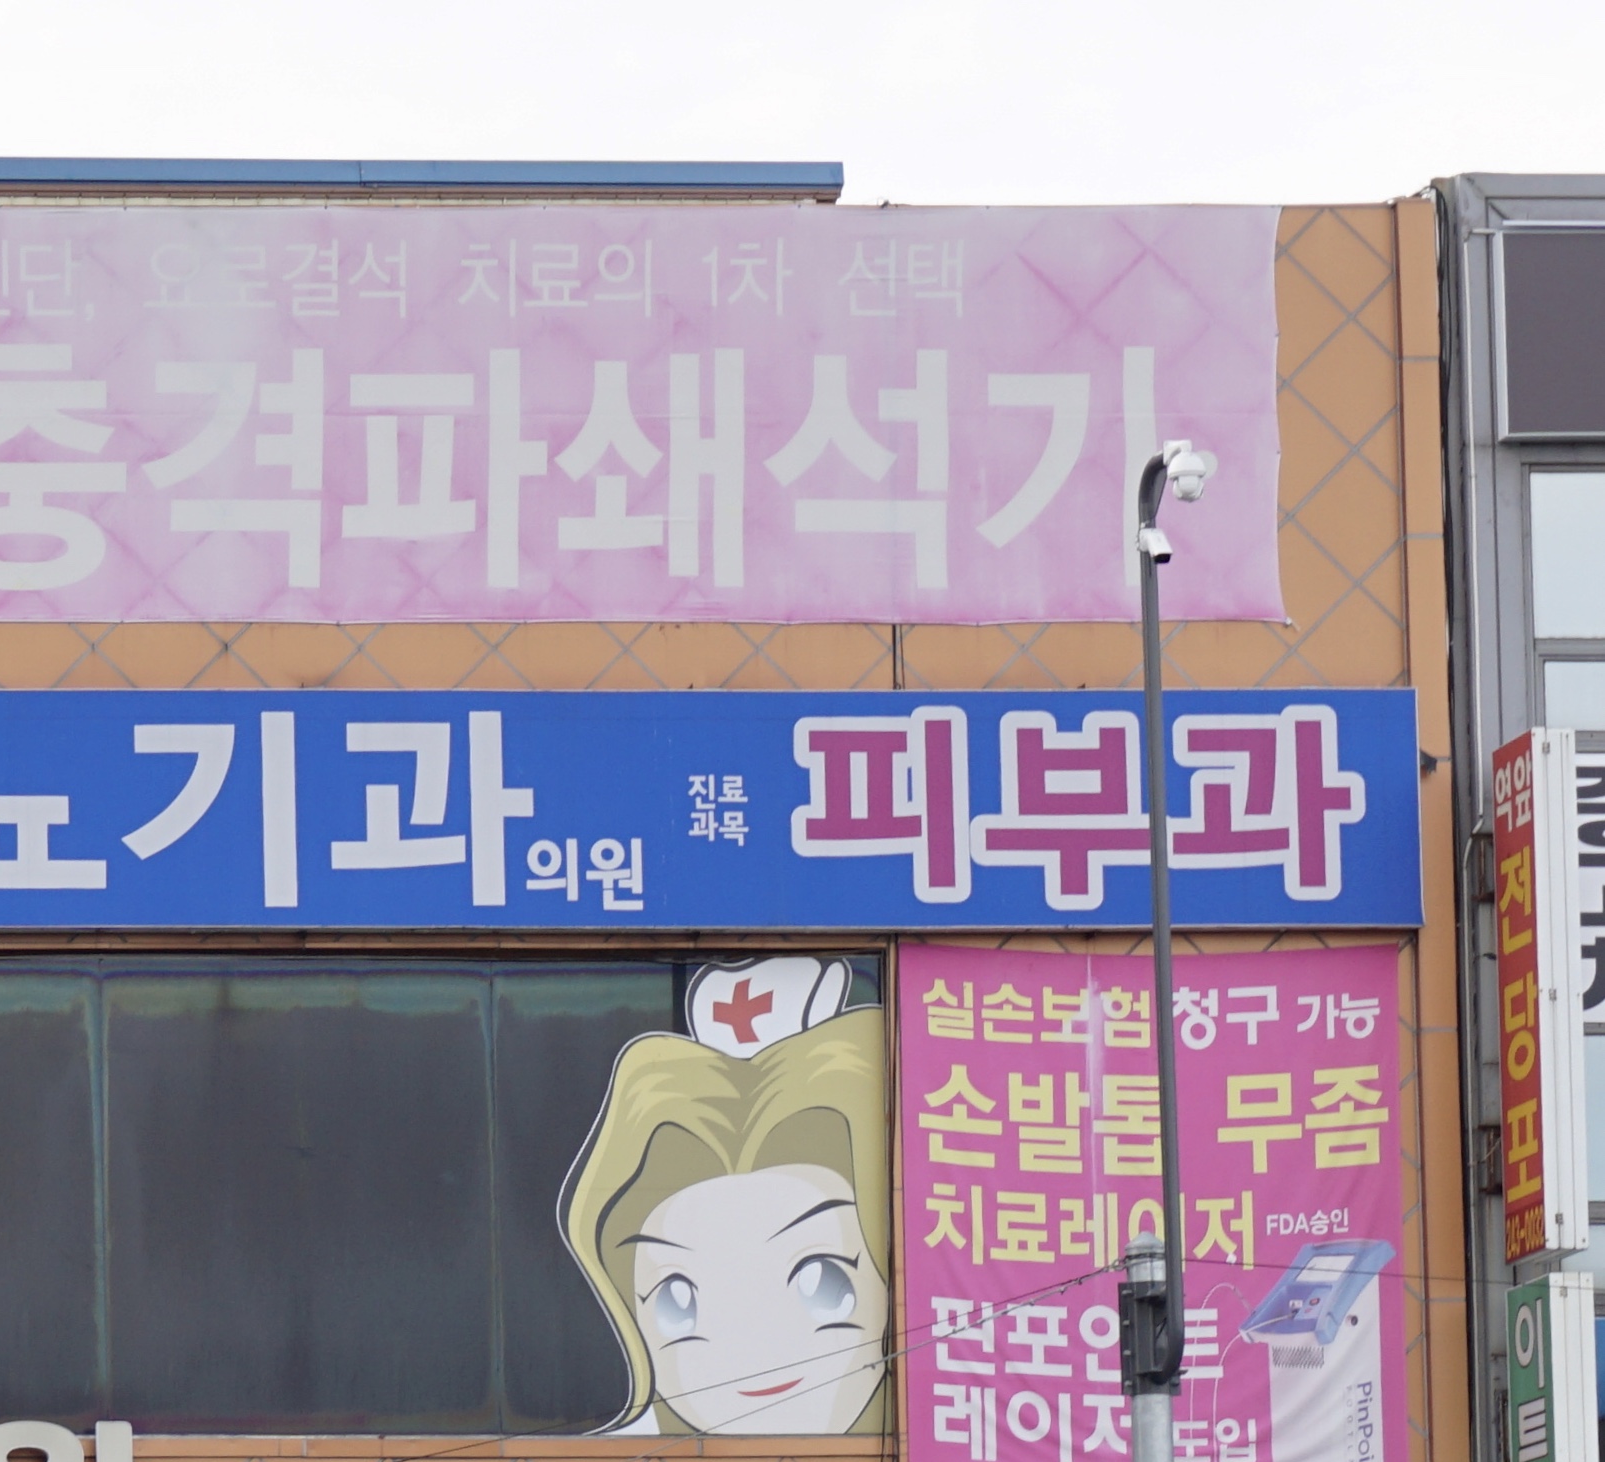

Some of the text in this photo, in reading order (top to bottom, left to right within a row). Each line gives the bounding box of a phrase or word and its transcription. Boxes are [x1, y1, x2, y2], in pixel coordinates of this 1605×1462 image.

[141, 238, 408, 318] 요로결석
[456, 237, 655, 318] 치료의
[701, 237, 793, 317] 1차
[837, 238, 965, 318] 선택
[688, 773, 750, 809] 진료
[791, 704, 1366, 911] 피부과
[688, 811, 751, 847] 과목
[525, 835, 645, 911] 의원
[1297, 991, 1381, 1041] 가능
[918, 1063, 1389, 1177] 손발톱 무좀
[1266, 1206, 1350, 1237] FDA승인
